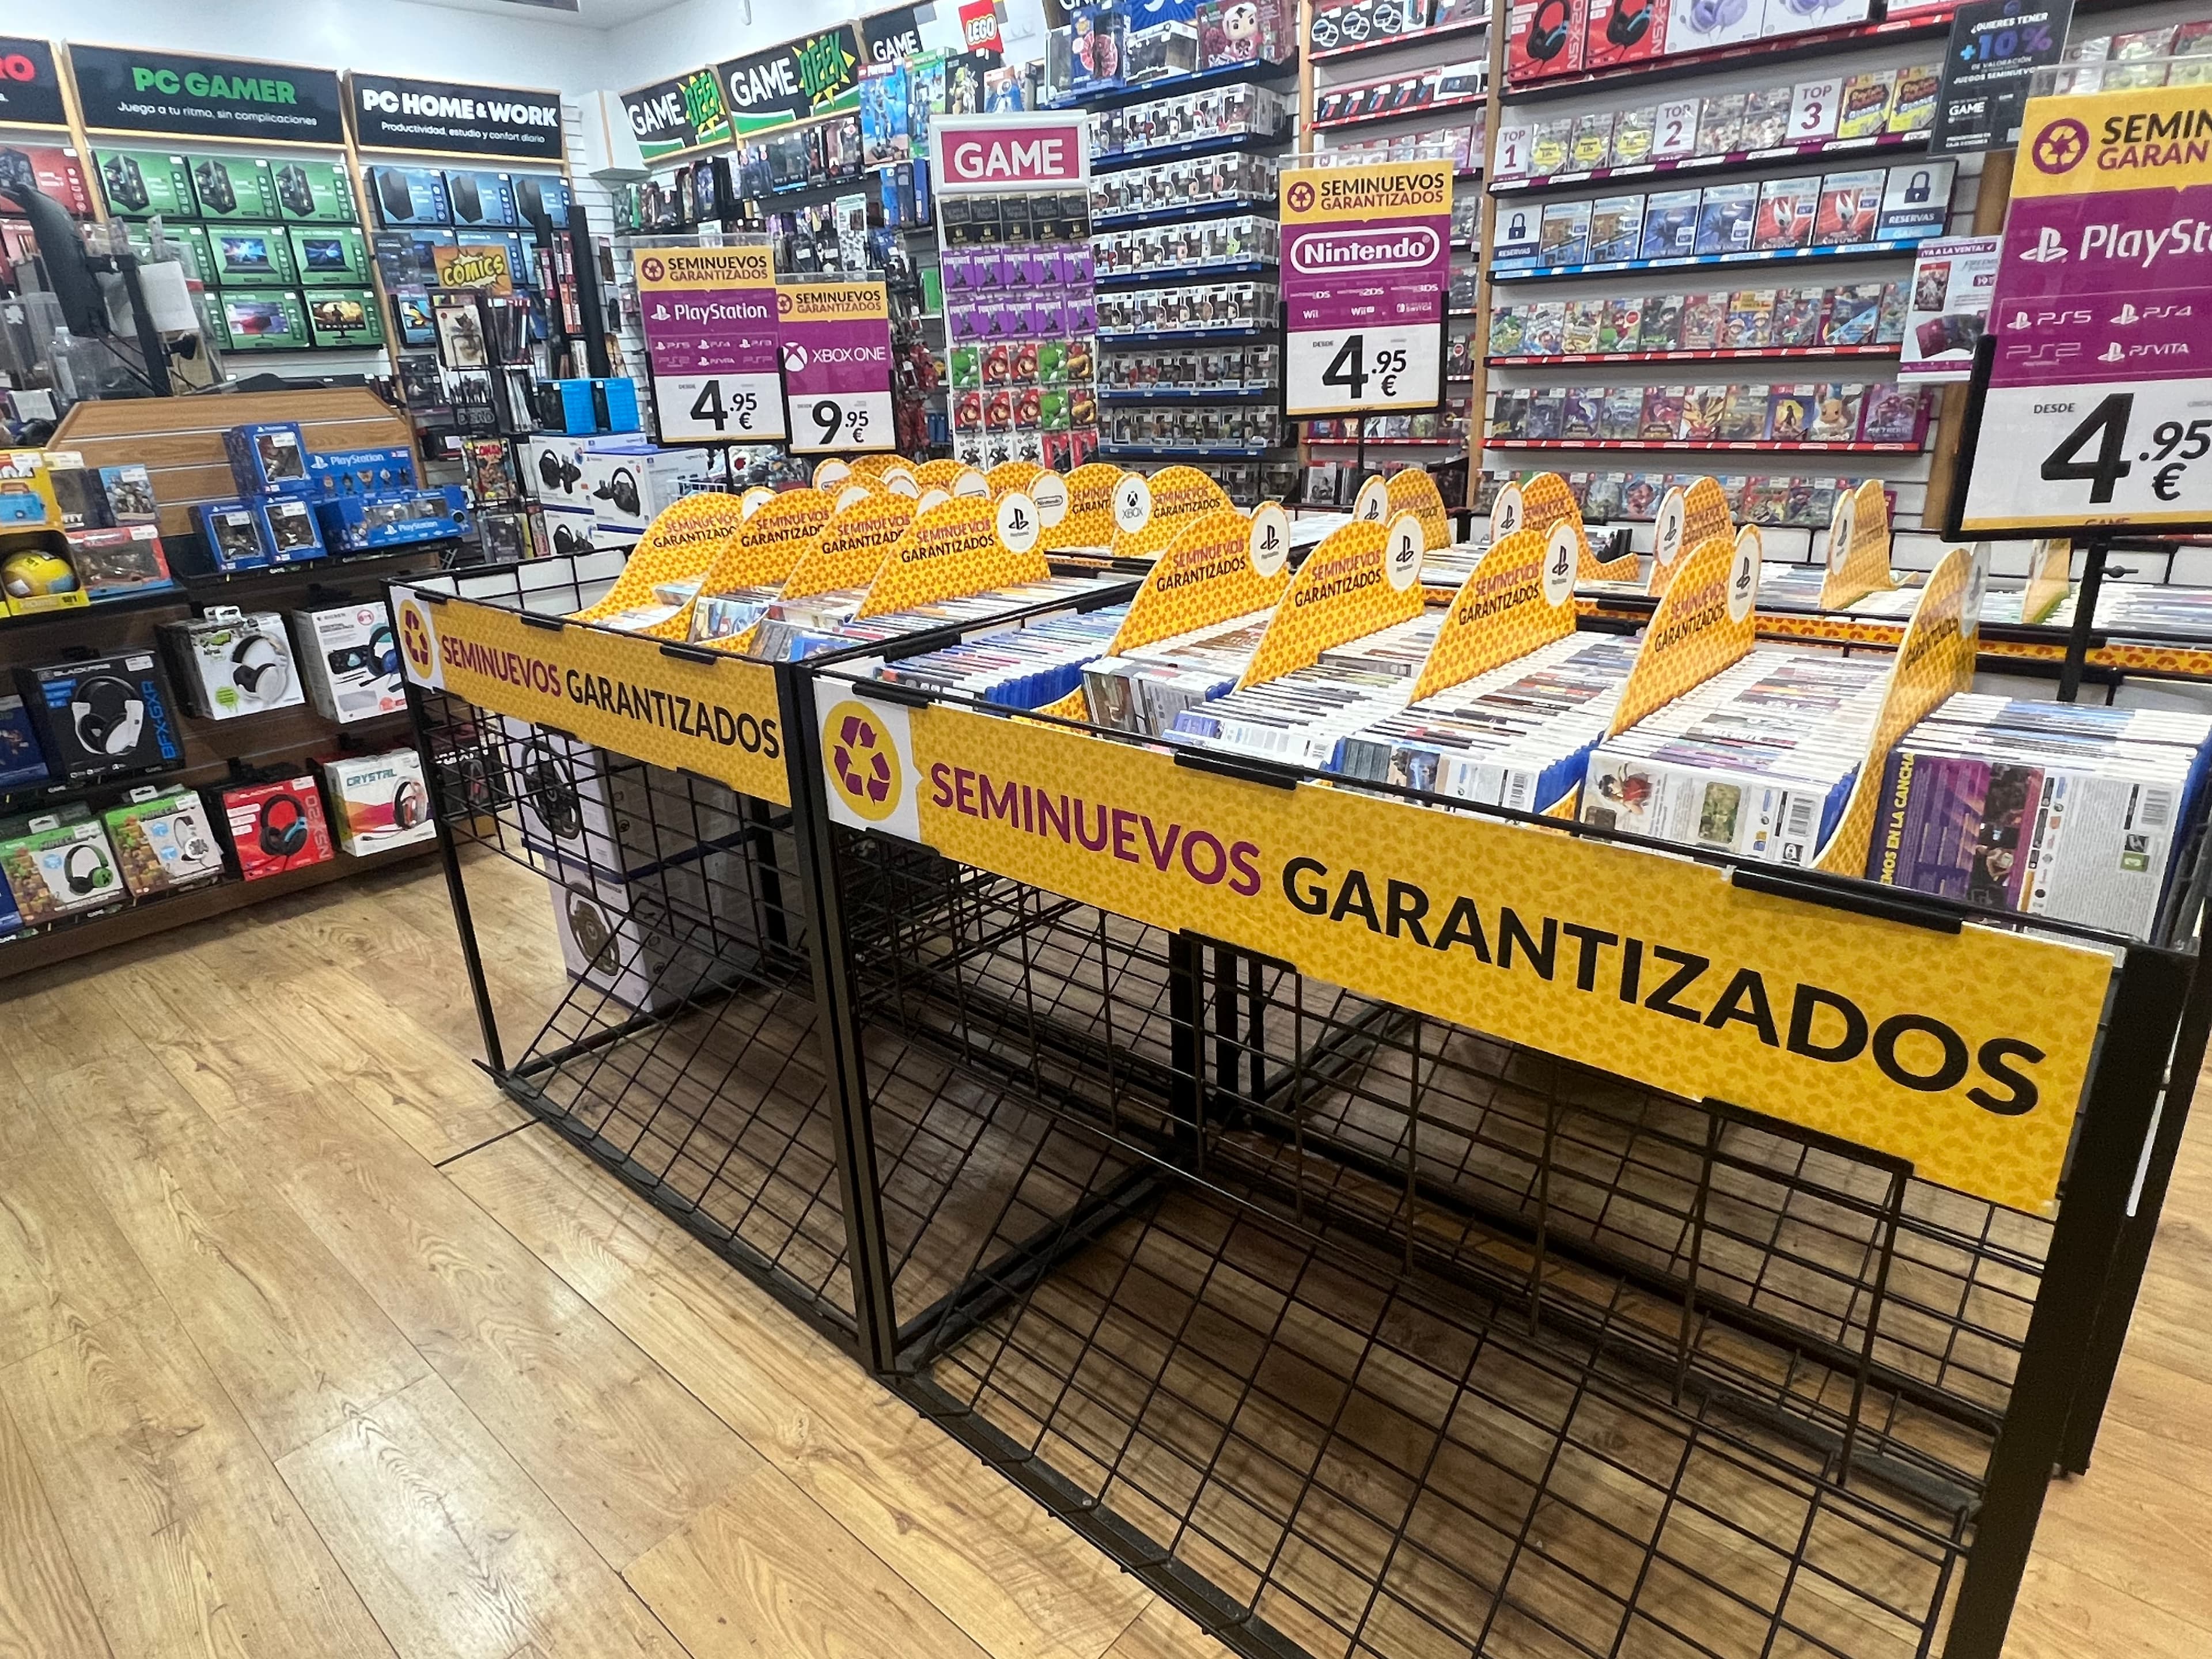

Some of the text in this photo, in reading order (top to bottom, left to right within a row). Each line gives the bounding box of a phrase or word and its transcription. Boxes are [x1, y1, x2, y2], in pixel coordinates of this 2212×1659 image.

[967, 15, 996, 43] LEGO
[873, 30, 919, 62] GAME
[132, 67, 297, 104] PC GAMER
[730, 58, 798, 107] GAME
[1801, 84, 1833, 100] TOP
[362, 89, 398, 113] PC
[1664, 104, 1691, 119] TOP
[1949, 101, 1985, 116] GAME
[118, 101, 156, 115] Juego
[158, 107, 167, 115] a
[169, 105, 181, 115] tu
[217, 110, 233, 119] sin
[234, 111, 317, 127] complicaciones
[628, 92, 685, 135] GAME
[1801, 101, 1823, 131] 3
[449, 126, 481, 139] estudio
[488, 128, 520, 142] confort
[521, 133, 545, 143] diario
[1502, 130, 1526, 143] TOP
[1663, 120, 1683, 147] 2
[953, 139, 1065, 179] GAME
[1505, 143, 1517, 169] 1
[2096, 139, 2210, 172] GARAN
[1321, 173, 1445, 196] SEMINUEVOS
[1321, 191, 1444, 210] GARANTIZADOS
[1888, 213, 1935, 224] RESERVAS
[1304, 237, 1426, 264] Nintendo
[442, 255, 505, 286] COMICS
[668, 256, 767, 270] SEMINUEVOS
[669, 268, 768, 282] GARANTIZADOS
[796, 290, 881, 303] SEMINUEVOS
[797, 301, 881, 314] GARANTIZADOS
[674, 302, 768, 325] PlayStation
[2037, 305, 2192, 326] PS5 PS4
[813, 346, 887, 362] XBOX ONE
[1381, 374, 1397, 397] €
[2033, 403, 2075, 414] DESDE
[738, 412, 753, 430] €
[852, 428, 864, 444] €
[329, 453, 385, 467] PlayStation
[2152, 462, 2187, 501] €
[1072, 487, 1114, 502] SEMINUE
[1072, 498, 1112, 514] GARANT
[755, 507, 830, 531] SEMINUEVOS
[1122, 509, 1144, 519] XBOX
[1153, 498, 1221, 518] GARANTIZADOS
[665, 512, 739, 533] SEMINUEVOS
[836, 514, 911, 536] SEMINUEVOS
[916, 519, 991, 543] SEMINUEVOS
[653, 526, 737, 548] GARANTIZADO
[741, 524, 825, 547] GARANTIZADO
[822, 529, 905, 554] GARANTIZAD
[902, 533, 994, 563] GARANTIZADOS
[1173, 539, 1244, 568] SEMINUEVOS
[1156, 555, 1247, 593] GARANTIZADOS
[1312, 548, 1381, 582] SEMINUEVOS
[1294, 568, 1381, 607] GARANTIZADOS
[1475, 561, 1540, 597] SEMINUEVOS
[1459, 582, 1540, 626] GARANTIZADOS
[1654, 601, 1725, 652] GARANTIZADOS
[442, 635, 781, 759] SEMINUEVOS GARANTIZADOS
[347, 768, 397, 787] CRYSTAL
[1880, 752, 1915, 885] EMOS EN LA CANCHA
[929, 762, 2048, 1118] SEMINUEVOS GARANTIZADOS
